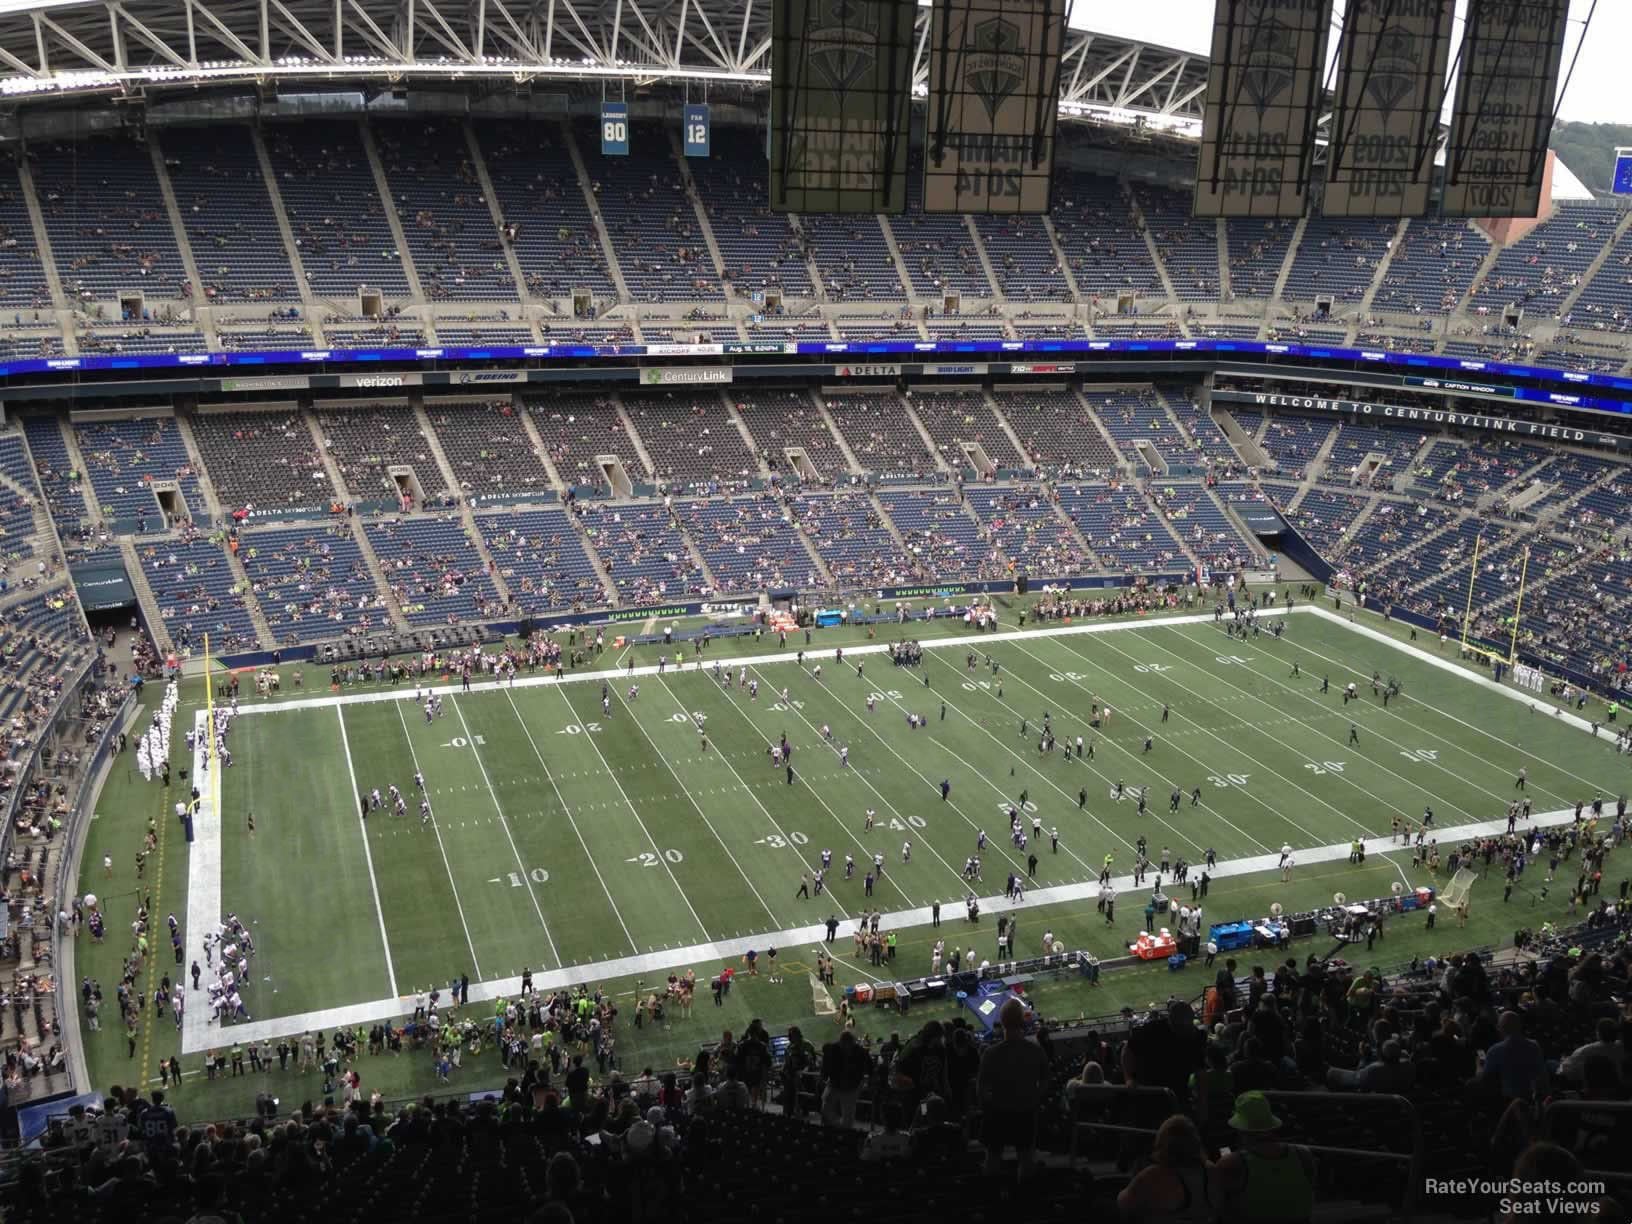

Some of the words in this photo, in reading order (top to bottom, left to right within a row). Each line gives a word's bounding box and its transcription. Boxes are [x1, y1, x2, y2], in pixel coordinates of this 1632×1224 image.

[604, 122, 626, 141] 80
[688, 124, 706, 143] 12
[475, 373, 518, 381] BOEING
[664, 370, 726, 383] CenturyLink
[855, 366, 896, 375] DELTA
[356, 376, 402, 387] verizon
[1445, 382, 1470, 390] CAPTION
[1471, 385, 1496, 393] WINDOW
[1255, 394, 1339, 410] WELCOME
[1352, 403, 1372, 413] TO
[1384, 408, 1516, 431] CENTURYLINK
[1530, 424, 1585, 441] FIELD
[1400, 750, 1437, 762] 10
[1304, 761, 1344, 775] 20
[1208, 773, 1247, 788] 30
[890, 815, 926, 831] 40
[766, 832, 808, 848] 30
[639, 849, 683, 867] 20
[507, 868, 549, 887] 10
